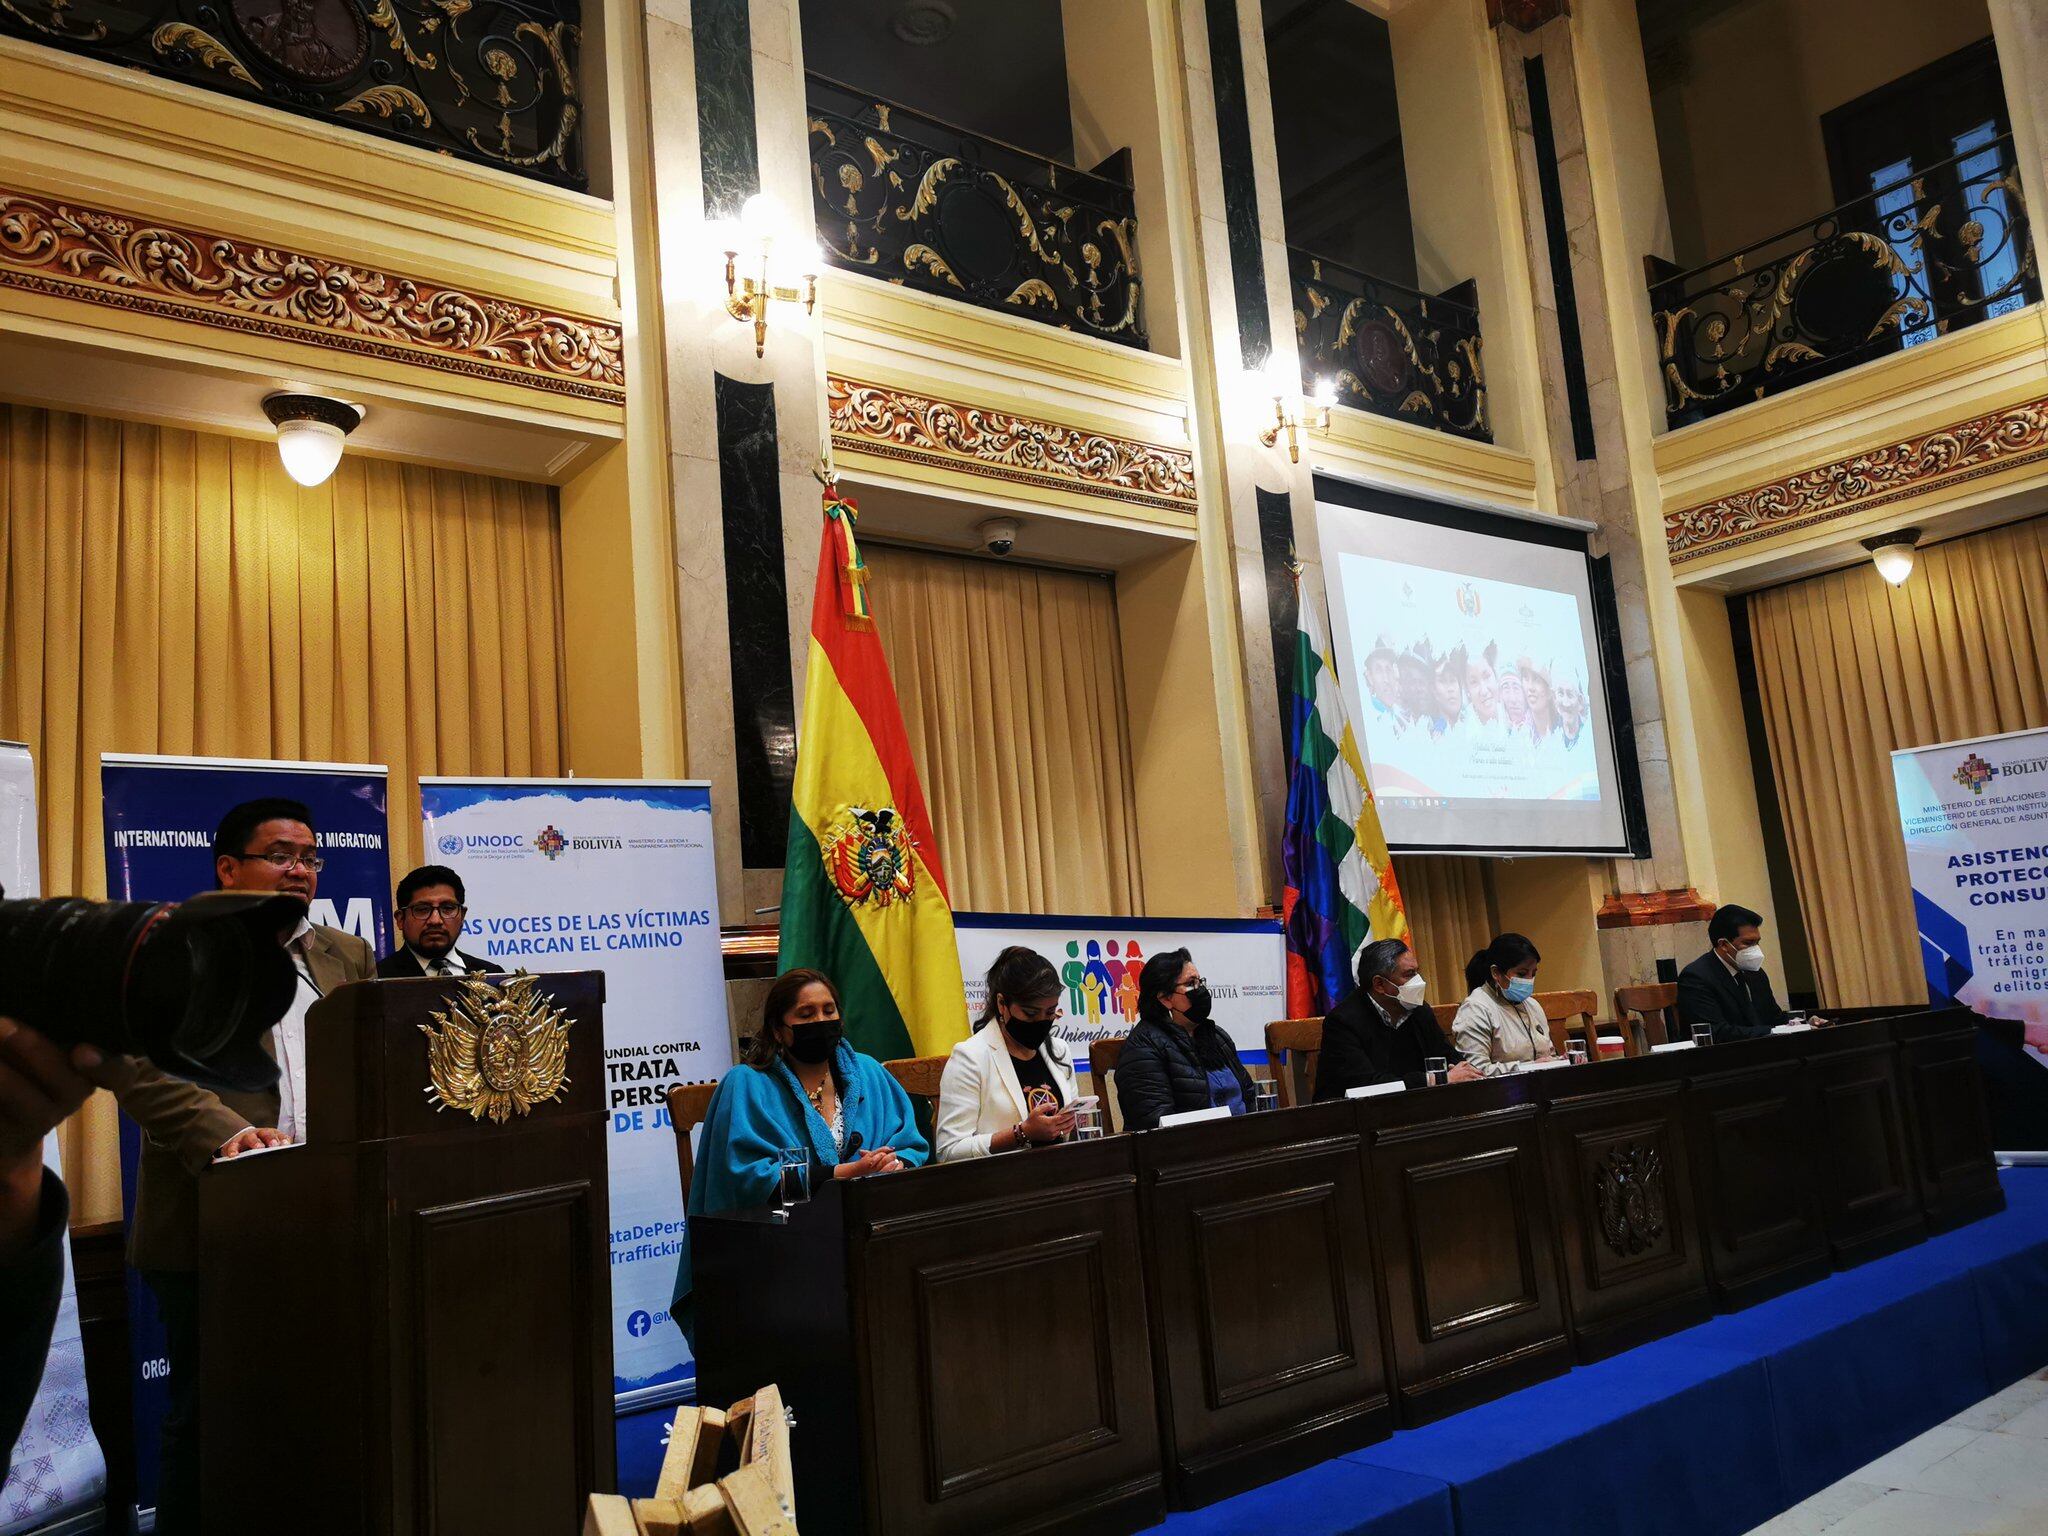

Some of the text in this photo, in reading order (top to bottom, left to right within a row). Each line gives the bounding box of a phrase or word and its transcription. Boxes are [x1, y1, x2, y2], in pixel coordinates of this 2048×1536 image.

[1923, 791, 2046, 814] MINISTERIO DE RELACIONES
[1905, 811, 1965, 825] VICEMINISTERIO
[1967, 810, 1977, 818] DE
[1980, 805, 2014, 816] GESTIÓN
[1910, 823, 1958, 835] DIRECCIÓN
[1960, 817, 2000, 829] GENERAL
[2004, 815, 2016, 823] DE
[114, 830, 211, 847] INTERNATIONAL
[326, 832, 382, 849] MIGRATION
[466, 836, 523, 846] UNODC
[573, 839, 622, 849] BOLIVIA
[1970, 887, 2048, 906] CONSU
[488, 916, 552, 934] VOCES
[558, 915, 582, 931] DE
[588, 913, 621, 930] LAS
[626, 909, 710, 928] VÍCTIMAS
[487, 931, 683, 956] MARCAN EL CAMINO
[1996, 929, 2046, 941] En ma
[1978, 940, 2044, 955] trata de
[1988, 954, 2044, 967] tráfico
[2011, 967, 2047, 980] migr
[1994, 980, 2048, 992] delitos
[1049, 1024, 1110, 1042] Uniendo
[652, 1041, 701, 1055] CONTRA
[607, 1058, 680, 1083] TRATA
[614, 1111, 644, 1133] DE
